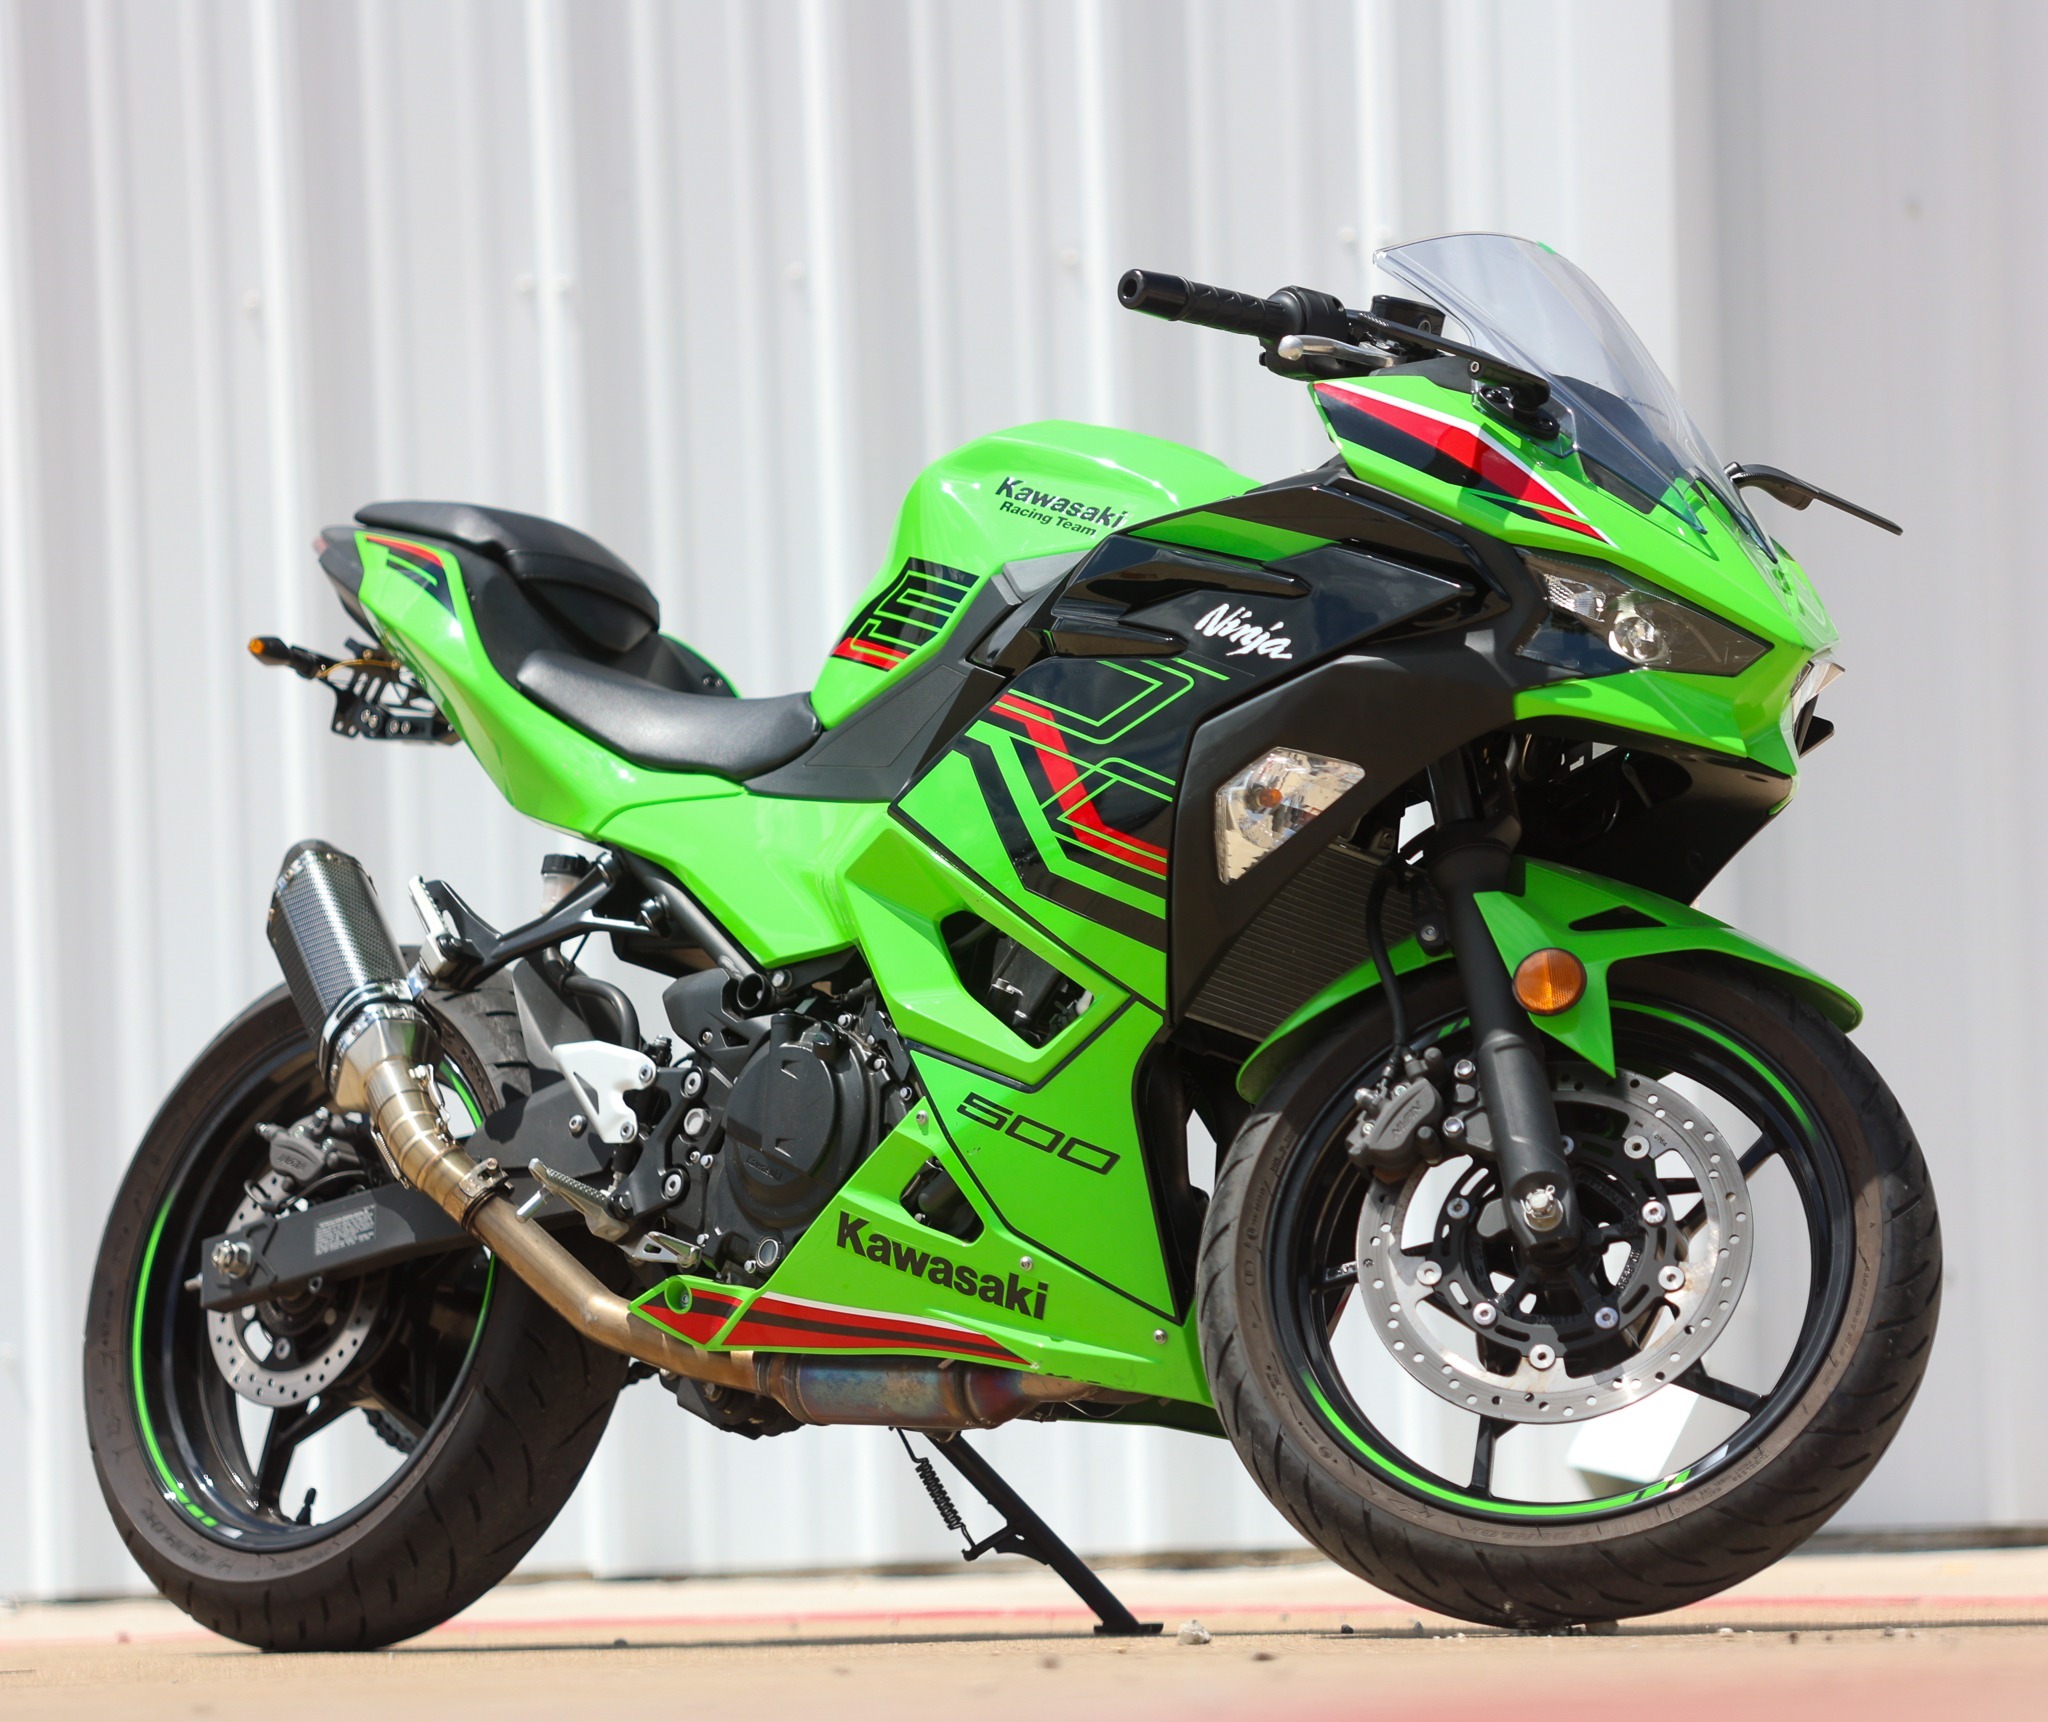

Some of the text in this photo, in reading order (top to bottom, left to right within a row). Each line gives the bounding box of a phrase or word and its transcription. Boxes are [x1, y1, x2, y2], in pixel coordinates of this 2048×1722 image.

[995, 476, 1126, 529] Kawasaki
[999, 500, 1097, 537] Racing Team
[1194, 603, 1293, 660] Ninja
[956, 1092, 1121, 1175] 500
[836, 1210, 1049, 1321] Kawasaki
